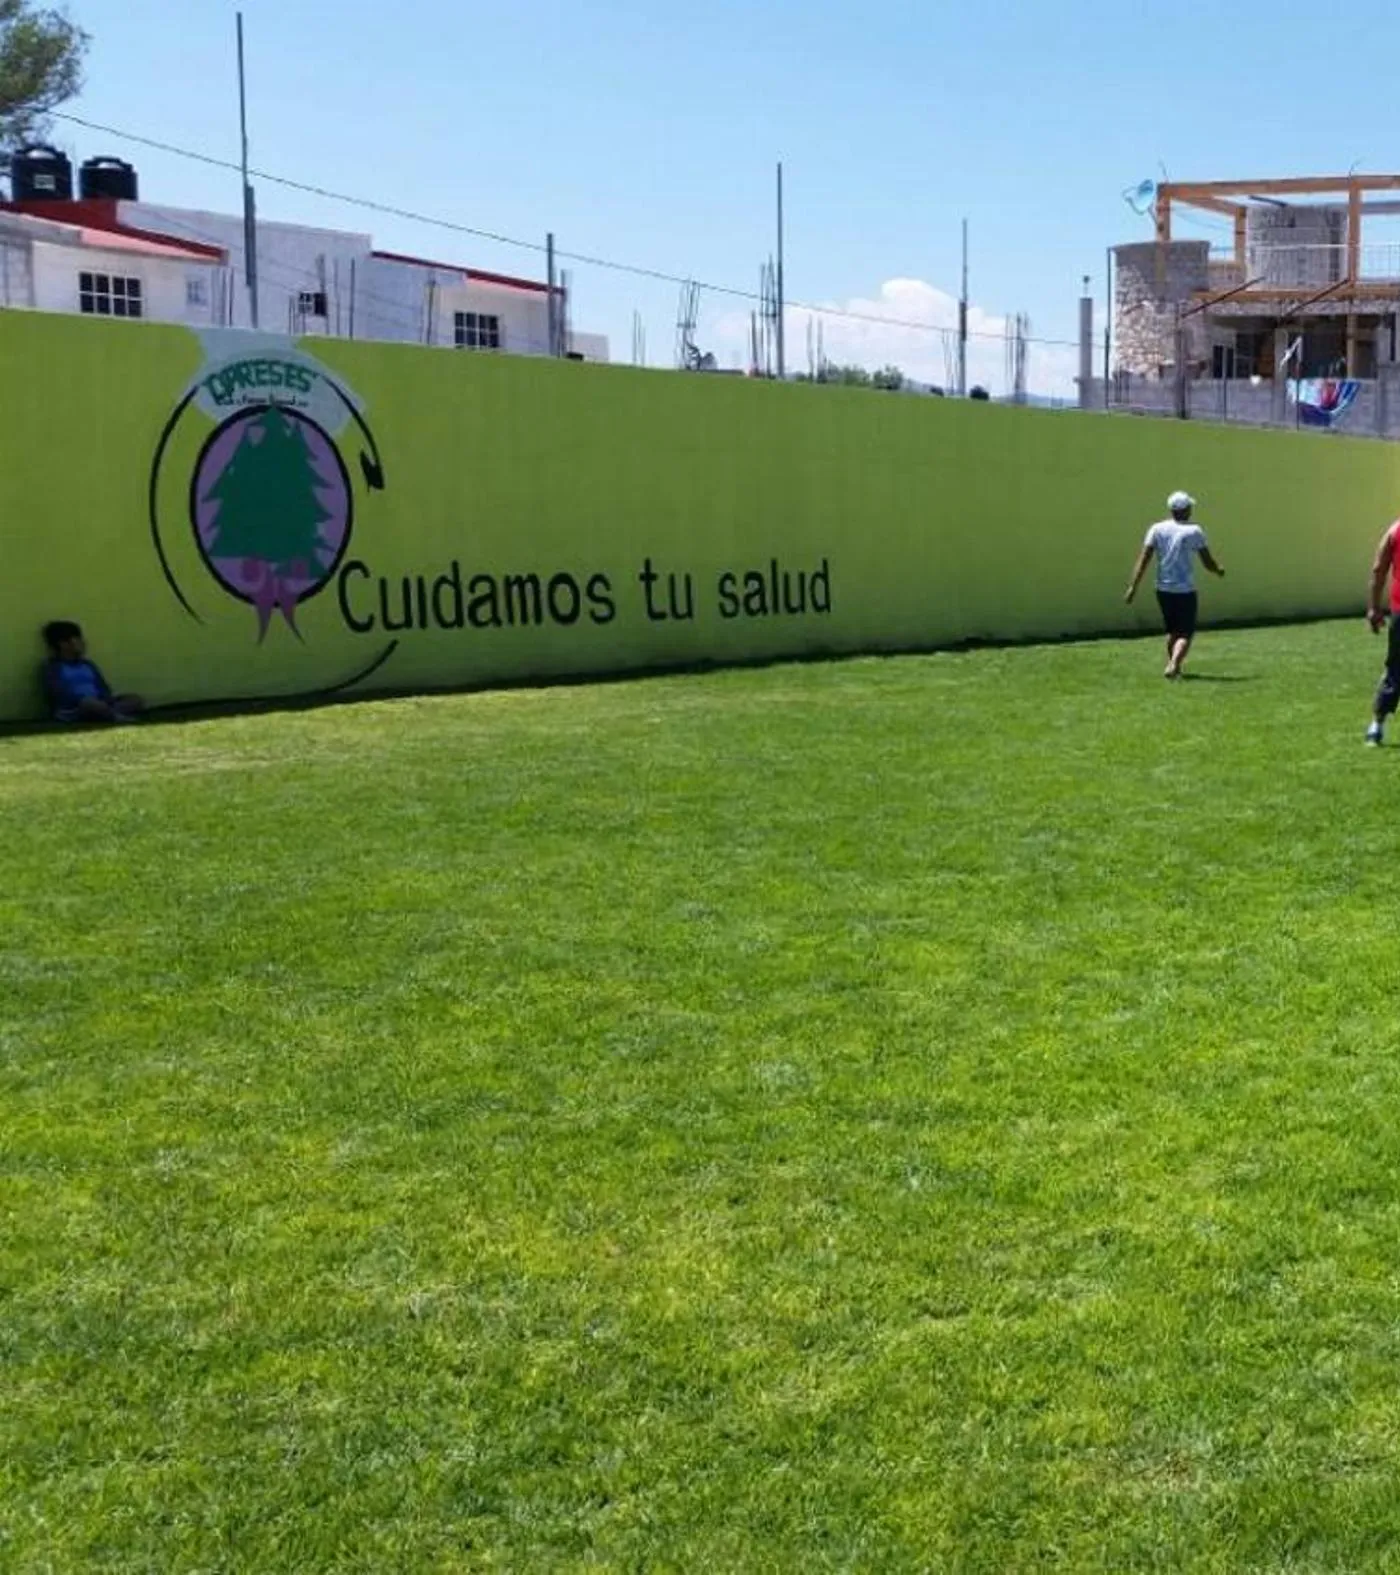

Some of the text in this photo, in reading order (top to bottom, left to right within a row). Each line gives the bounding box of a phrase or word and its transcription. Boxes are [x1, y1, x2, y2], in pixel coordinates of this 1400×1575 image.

[338, 558, 831, 633] Cuidamos tu salud
